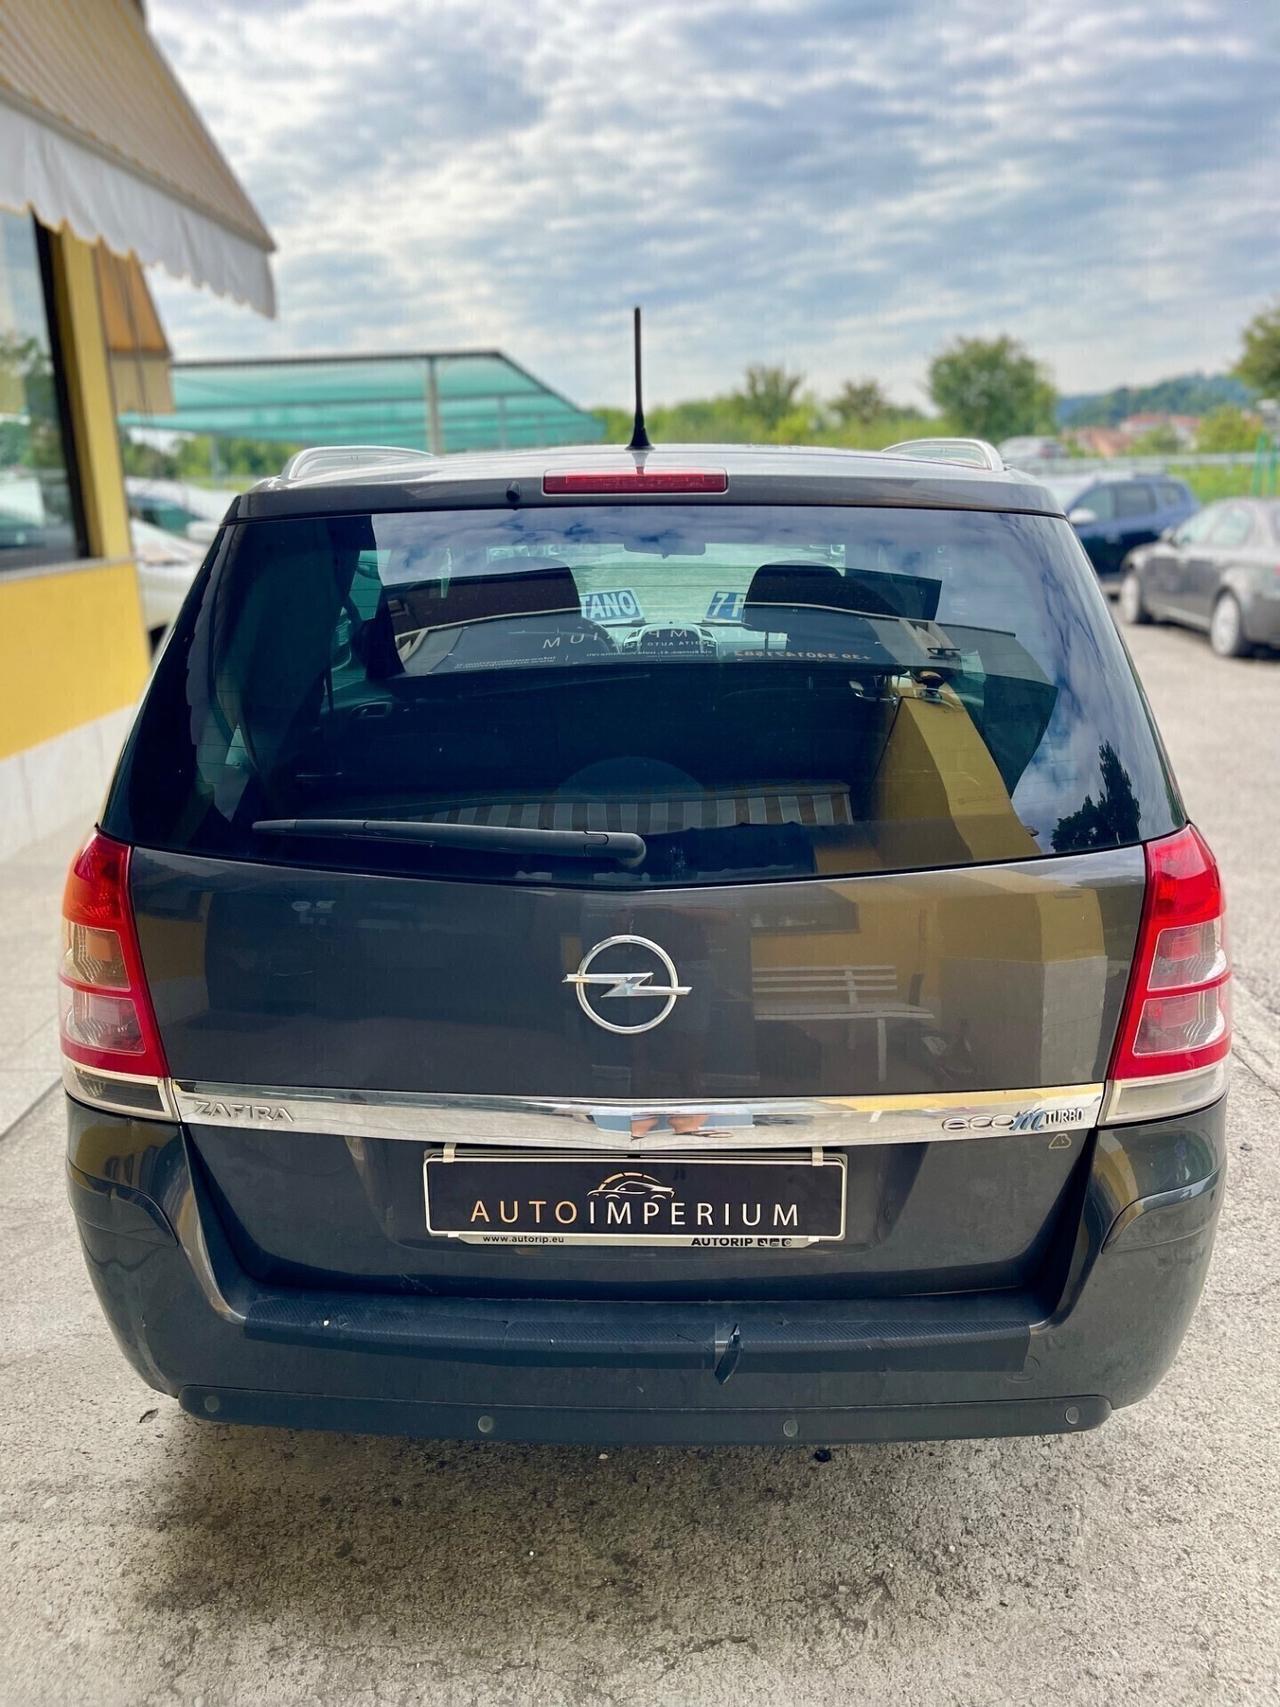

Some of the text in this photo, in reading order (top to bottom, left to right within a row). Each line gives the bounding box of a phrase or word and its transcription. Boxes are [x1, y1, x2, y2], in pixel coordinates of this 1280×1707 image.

[711, 593, 730, 616] 7
[195, 1101, 294, 1122] ZAFIRA
[1046, 1108, 1084, 1124] TURBO
[470, 1200, 798, 1226] AUTOIMPERIUM
[482, 1235, 565, 1244] www.autorip.eu
[691, 1237, 753, 1247] AUTORIP
